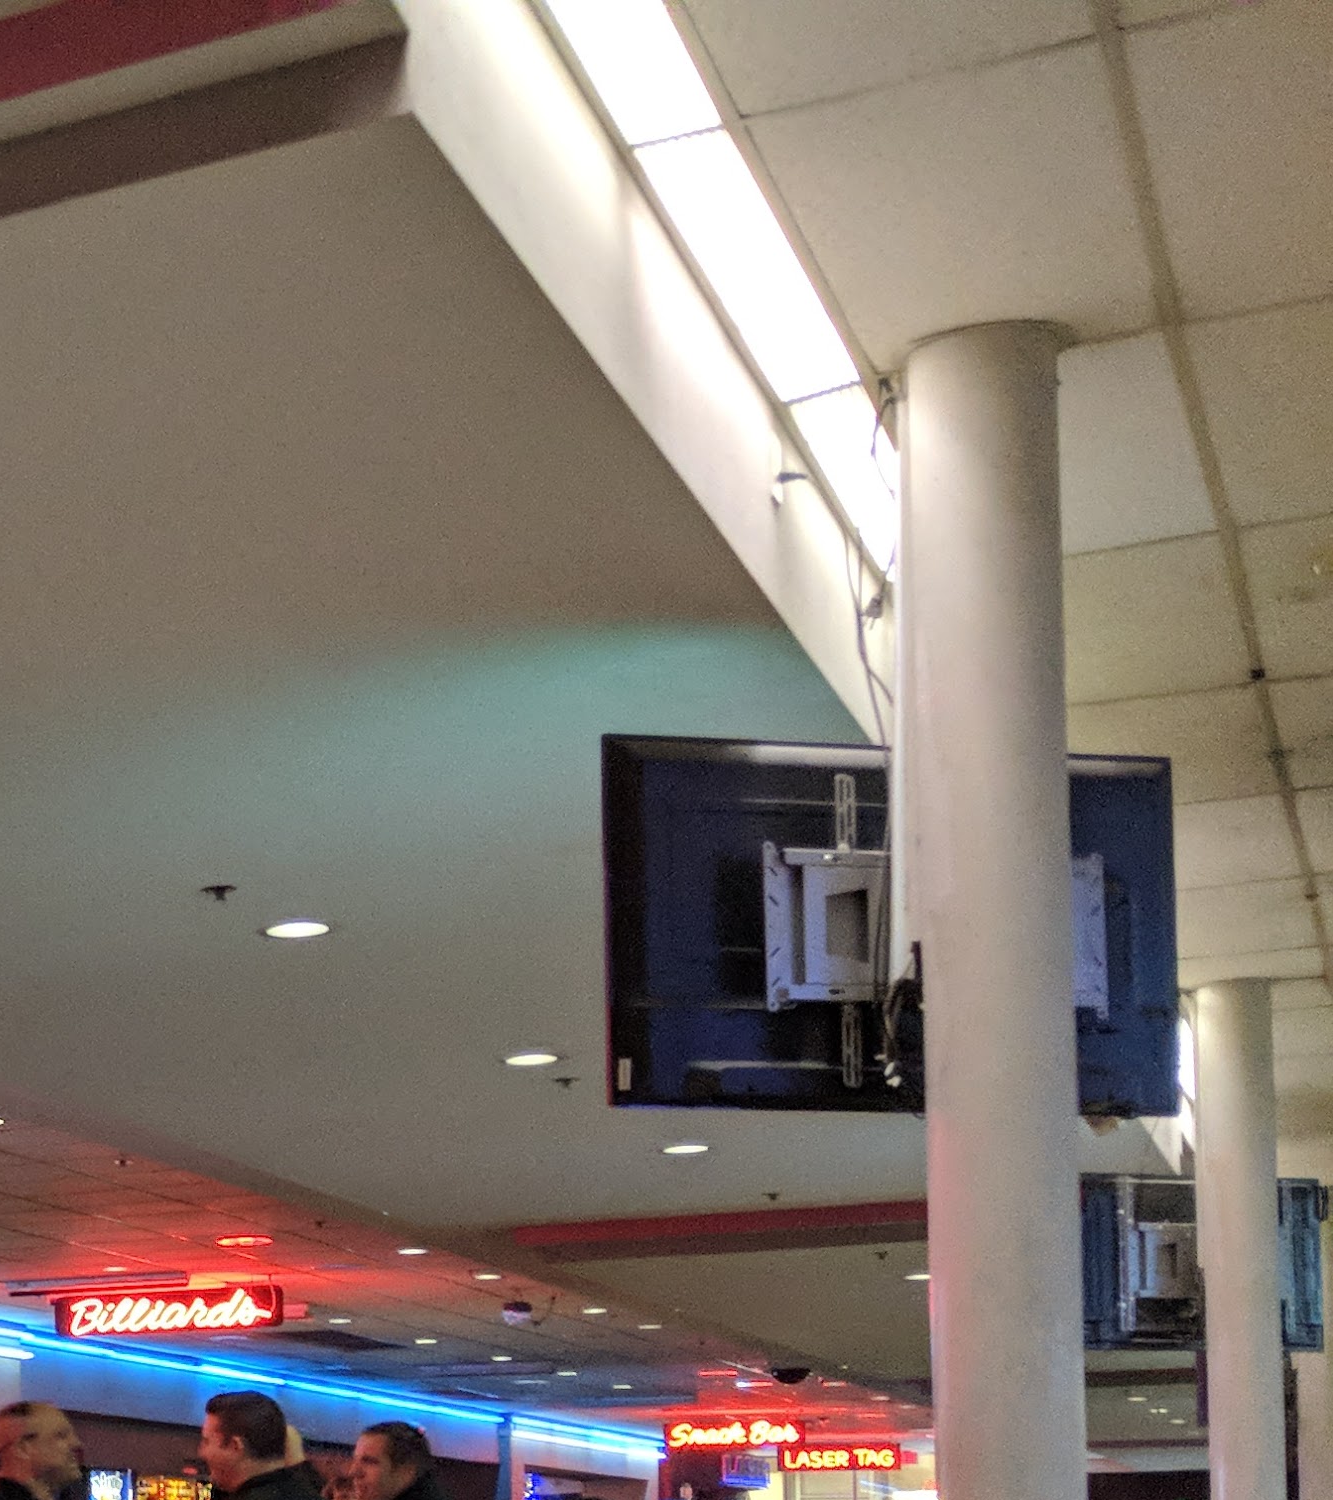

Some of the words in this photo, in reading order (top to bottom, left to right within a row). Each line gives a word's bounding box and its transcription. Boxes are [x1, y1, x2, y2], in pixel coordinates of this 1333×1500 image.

[70, 1288, 272, 1336] Billiards
[669, 1422, 747, 1448] Snack
[749, 1420, 800, 1445] Bar
[783, 1450, 849, 1469] LASER
[853, 1448, 895, 1468] TAG
